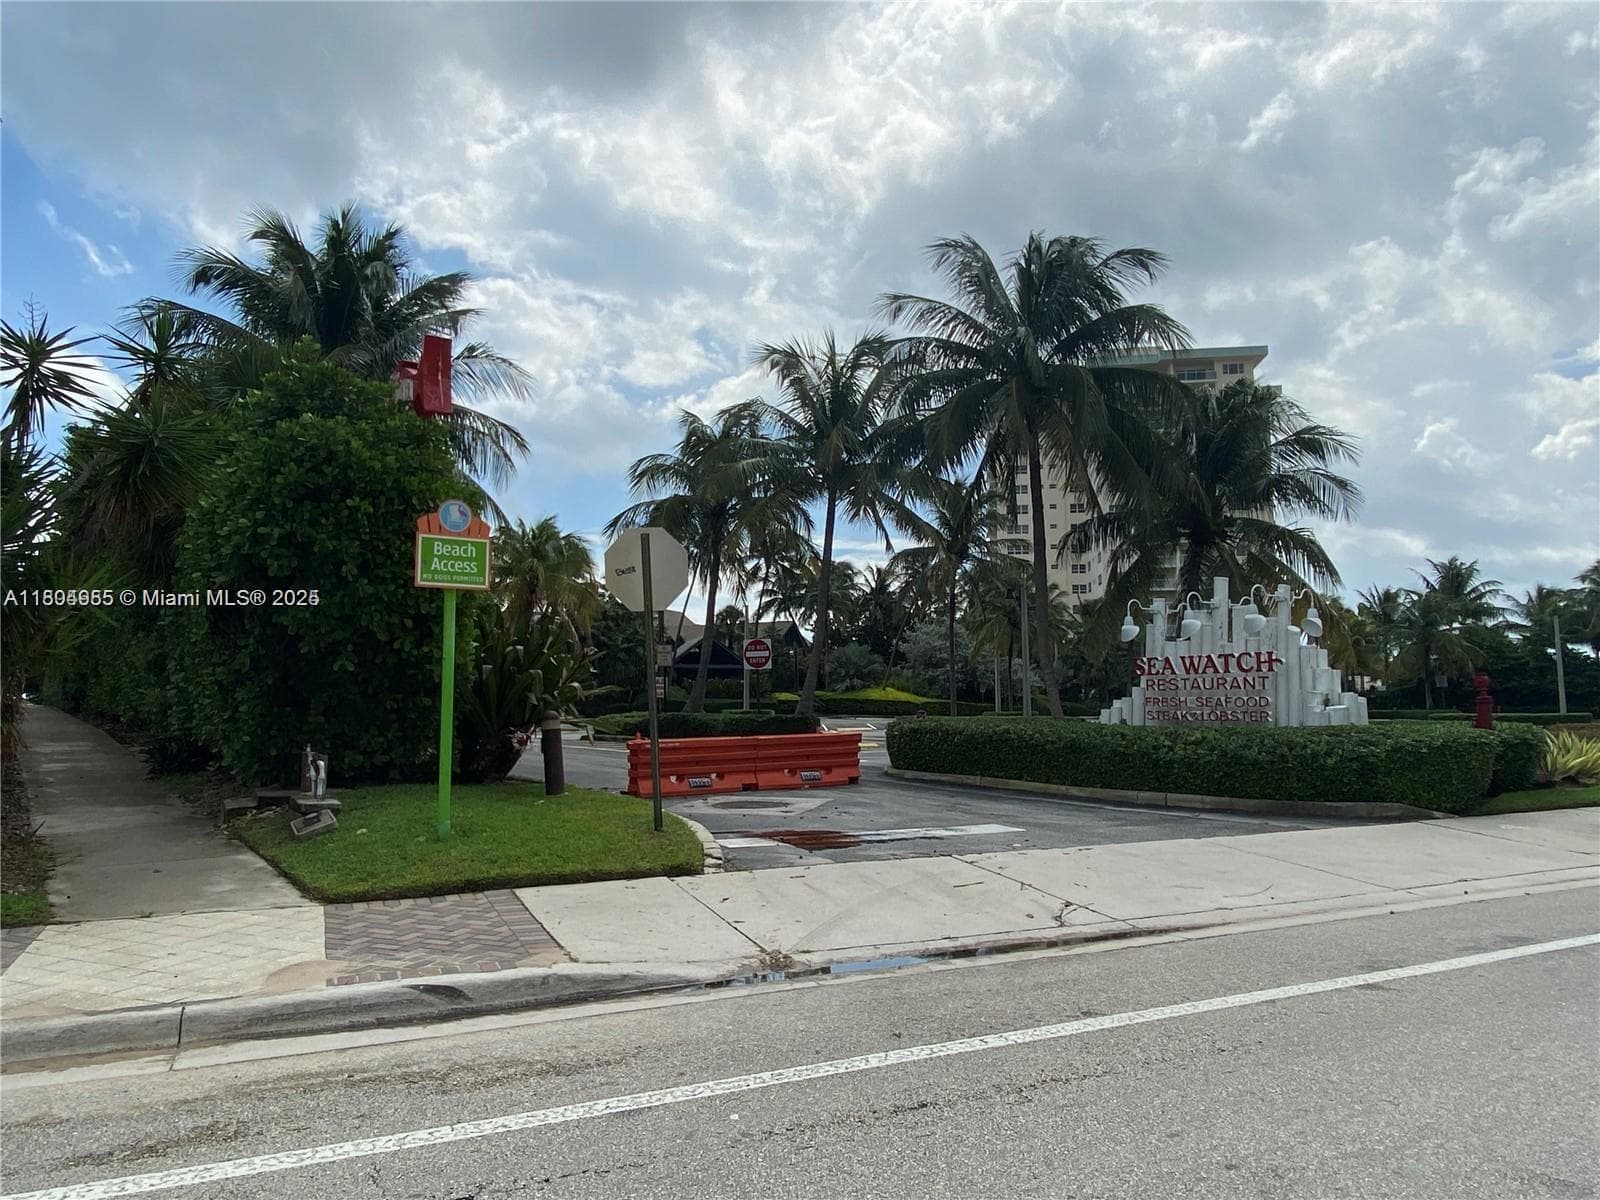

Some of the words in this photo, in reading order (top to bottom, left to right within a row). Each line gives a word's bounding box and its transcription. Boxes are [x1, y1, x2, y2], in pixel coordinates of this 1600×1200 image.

[434, 541, 476, 557] Beach
[431, 557, 478, 573] Access
[1135, 657, 1178, 677] SEA
[1180, 651, 1285, 675] WATCH
[1146, 676, 1270, 691] RESTAURANT
[1145, 696, 1188, 708] FRESH
[1195, 695, 1271, 709] SEAFOOD
